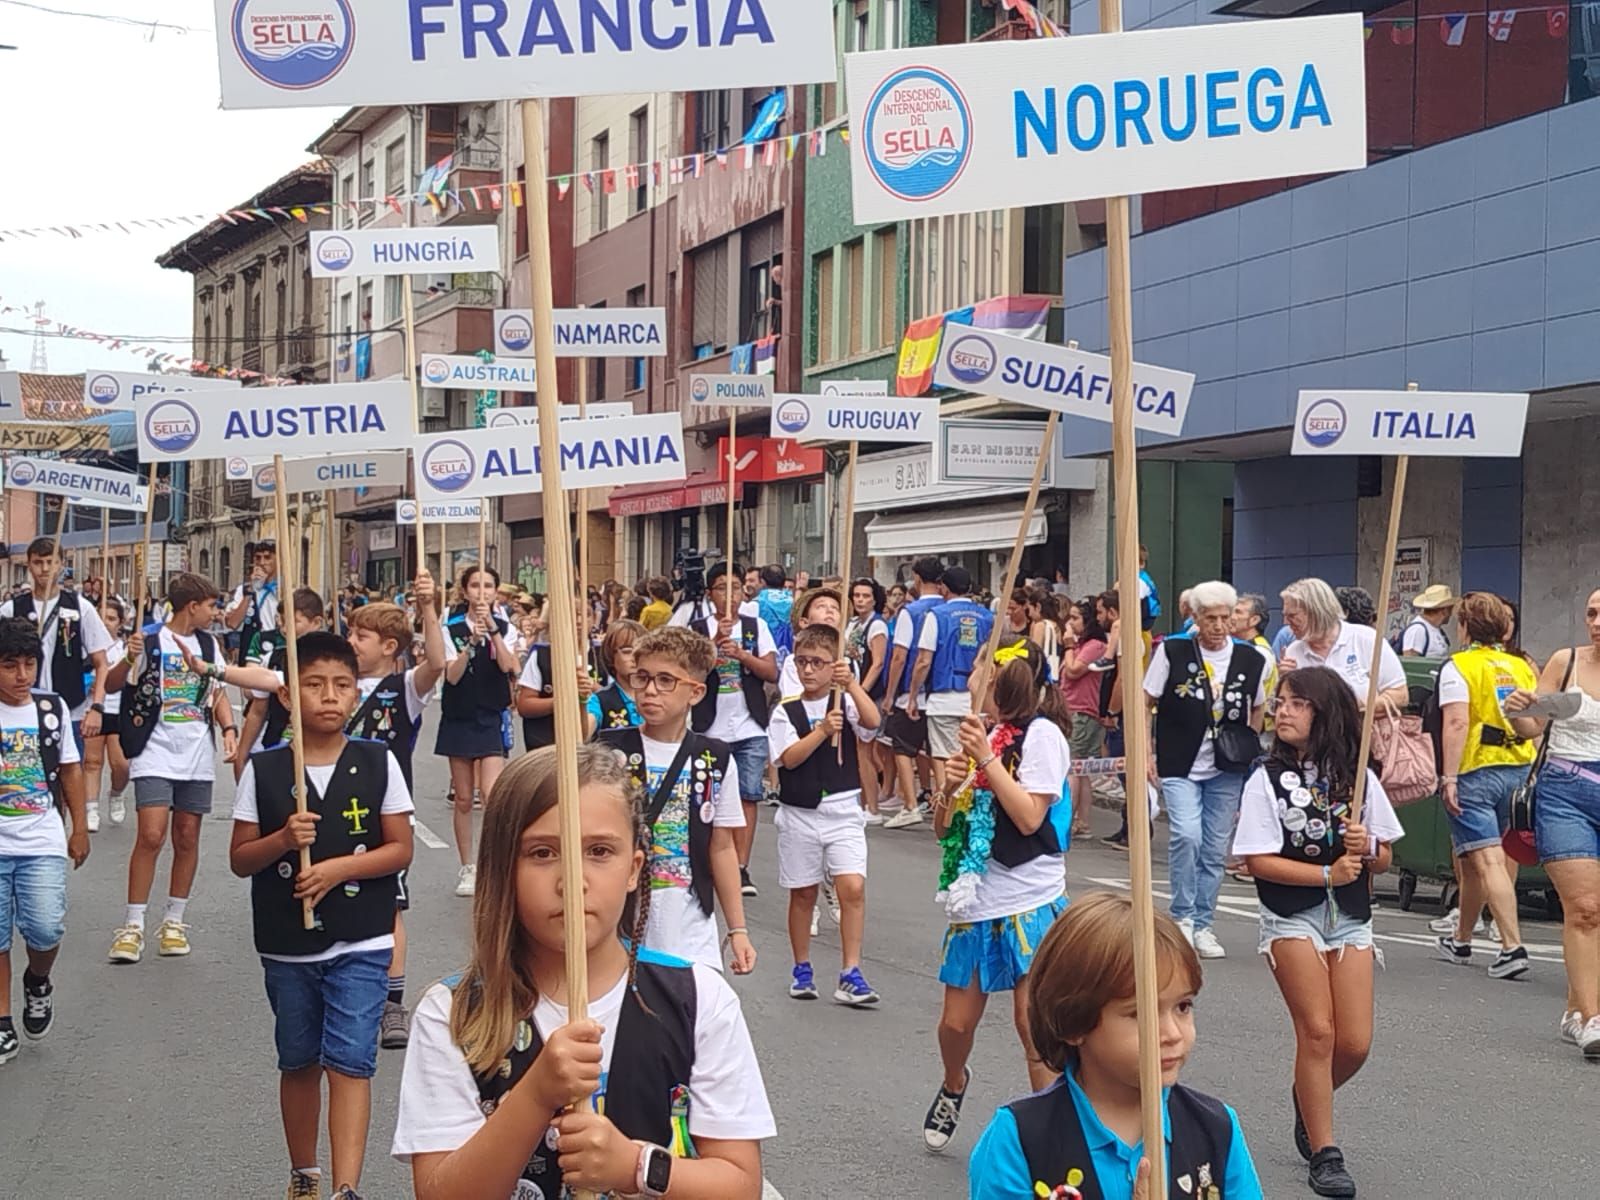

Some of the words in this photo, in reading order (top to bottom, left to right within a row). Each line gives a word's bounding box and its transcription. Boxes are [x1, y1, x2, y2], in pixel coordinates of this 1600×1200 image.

[252, 23, 336, 45] SELLA
[408, 0, 776, 62] FRANCIA
[894, 87, 941, 103] DESCENSO
[883, 99, 953, 116] INTERNACIONAL
[1013, 63, 1332, 159] NORUEGA
[910, 114, 927, 127] DEL
[884, 127, 956, 154] SELLA
[373, 236, 475, 264] HUNGRÍA
[954, 354, 988, 369] SELLA
[716, 383, 766, 399] POLONIA
[154, 423, 192, 436] SELLA
[223, 403, 386, 440] AUSTRIA
[828, 409, 922, 431] URUGUAY
[1309, 419, 1339, 431] SELLA
[1372, 411, 1477, 439] ITALIA
[317, 462, 377, 481] CHILE
[430, 462, 467, 476] SELLA
[895, 461, 927, 490] SAN
[35, 469, 132, 498] ARGENTINA
